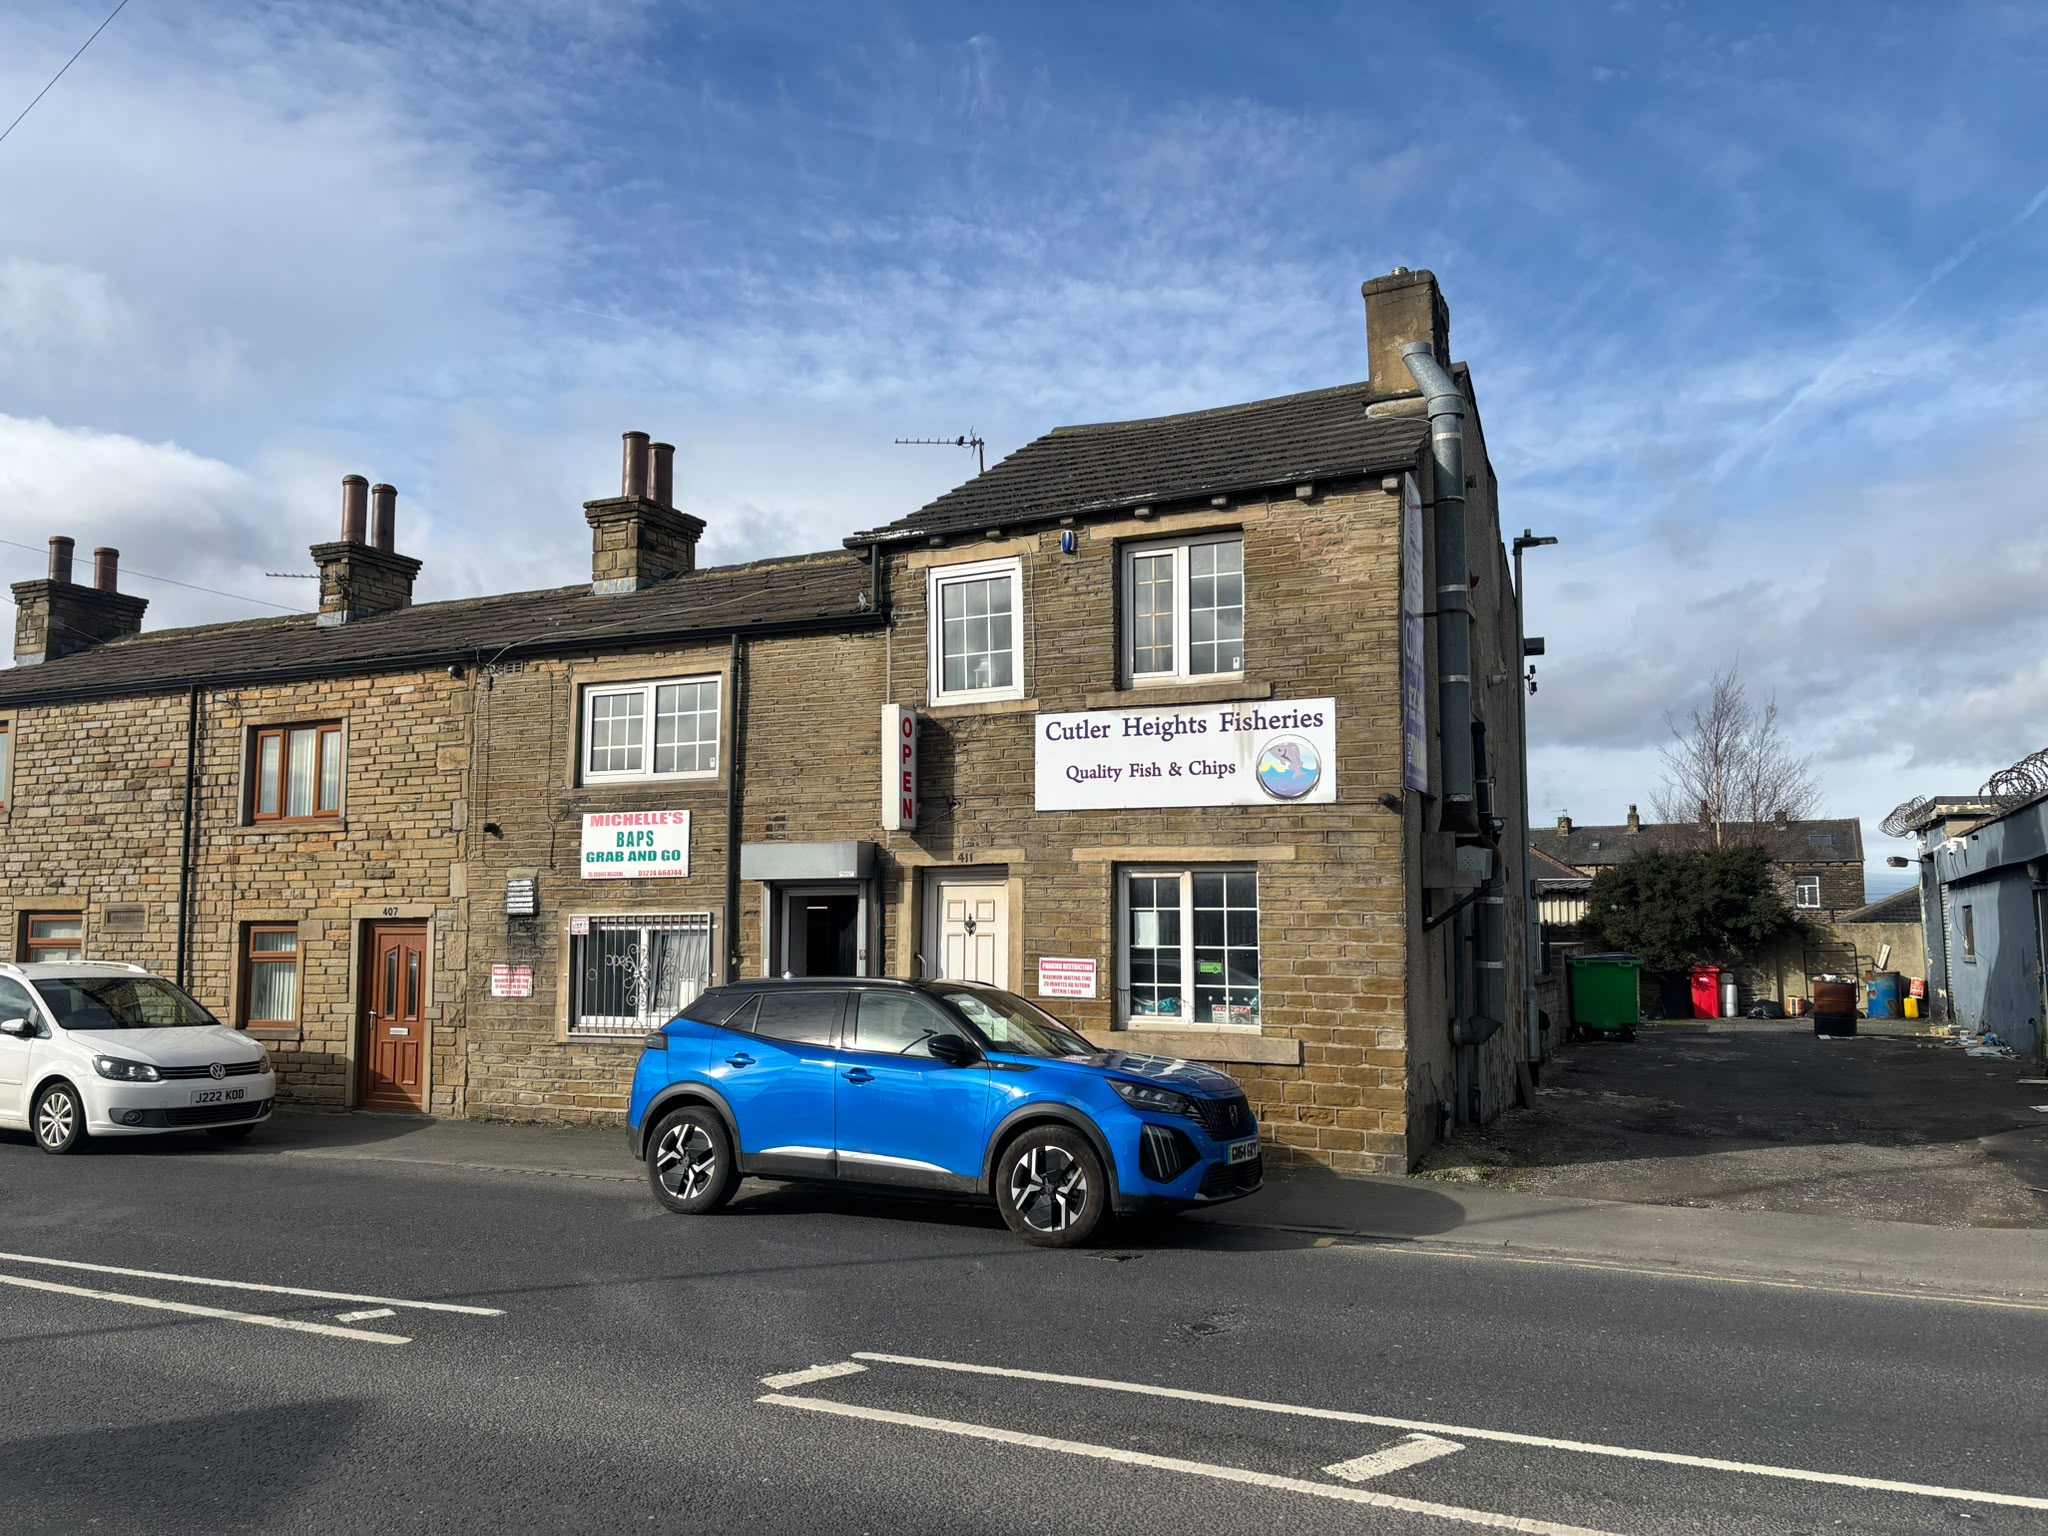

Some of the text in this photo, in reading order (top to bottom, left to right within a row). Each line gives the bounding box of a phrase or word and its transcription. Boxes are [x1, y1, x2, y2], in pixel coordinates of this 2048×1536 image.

[1045, 708, 1324, 742] Cutler Heights Fisheries
[901, 716, 913, 820] OPEN
[1065, 759, 1236, 783] Quality Fish & Chips
[590, 811, 684, 827] MICHELLE'S
[616, 830, 654, 848] BAPS
[586, 849, 681, 863] GRAB AND GO
[957, 852, 974, 863] 411
[382, 906, 399, 916] 407
[195, 1091, 222, 1104] J222
